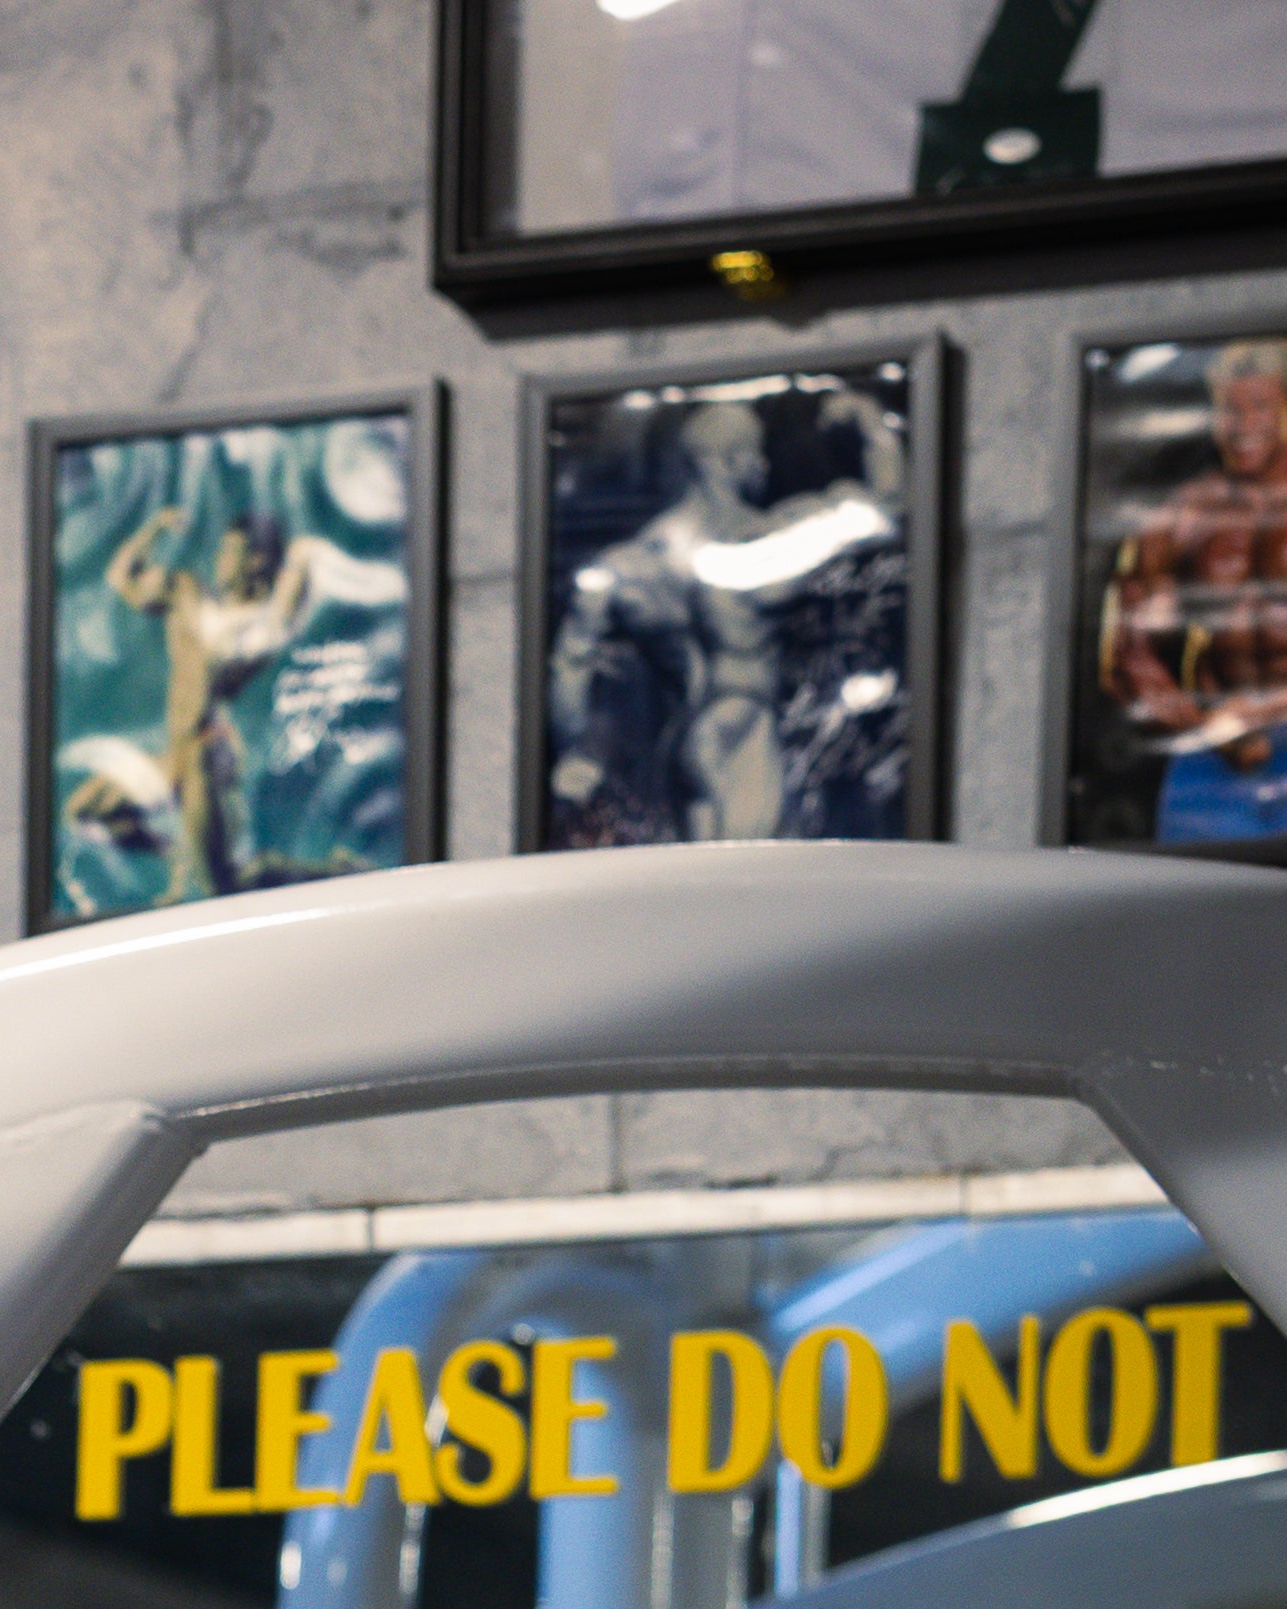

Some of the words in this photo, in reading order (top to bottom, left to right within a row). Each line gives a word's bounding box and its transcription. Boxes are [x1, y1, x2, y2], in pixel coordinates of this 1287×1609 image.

[75, 1336, 618, 1520] PLEASE
[666, 1326, 889, 1494] DO
[939, 1303, 1251, 1483] NOT
